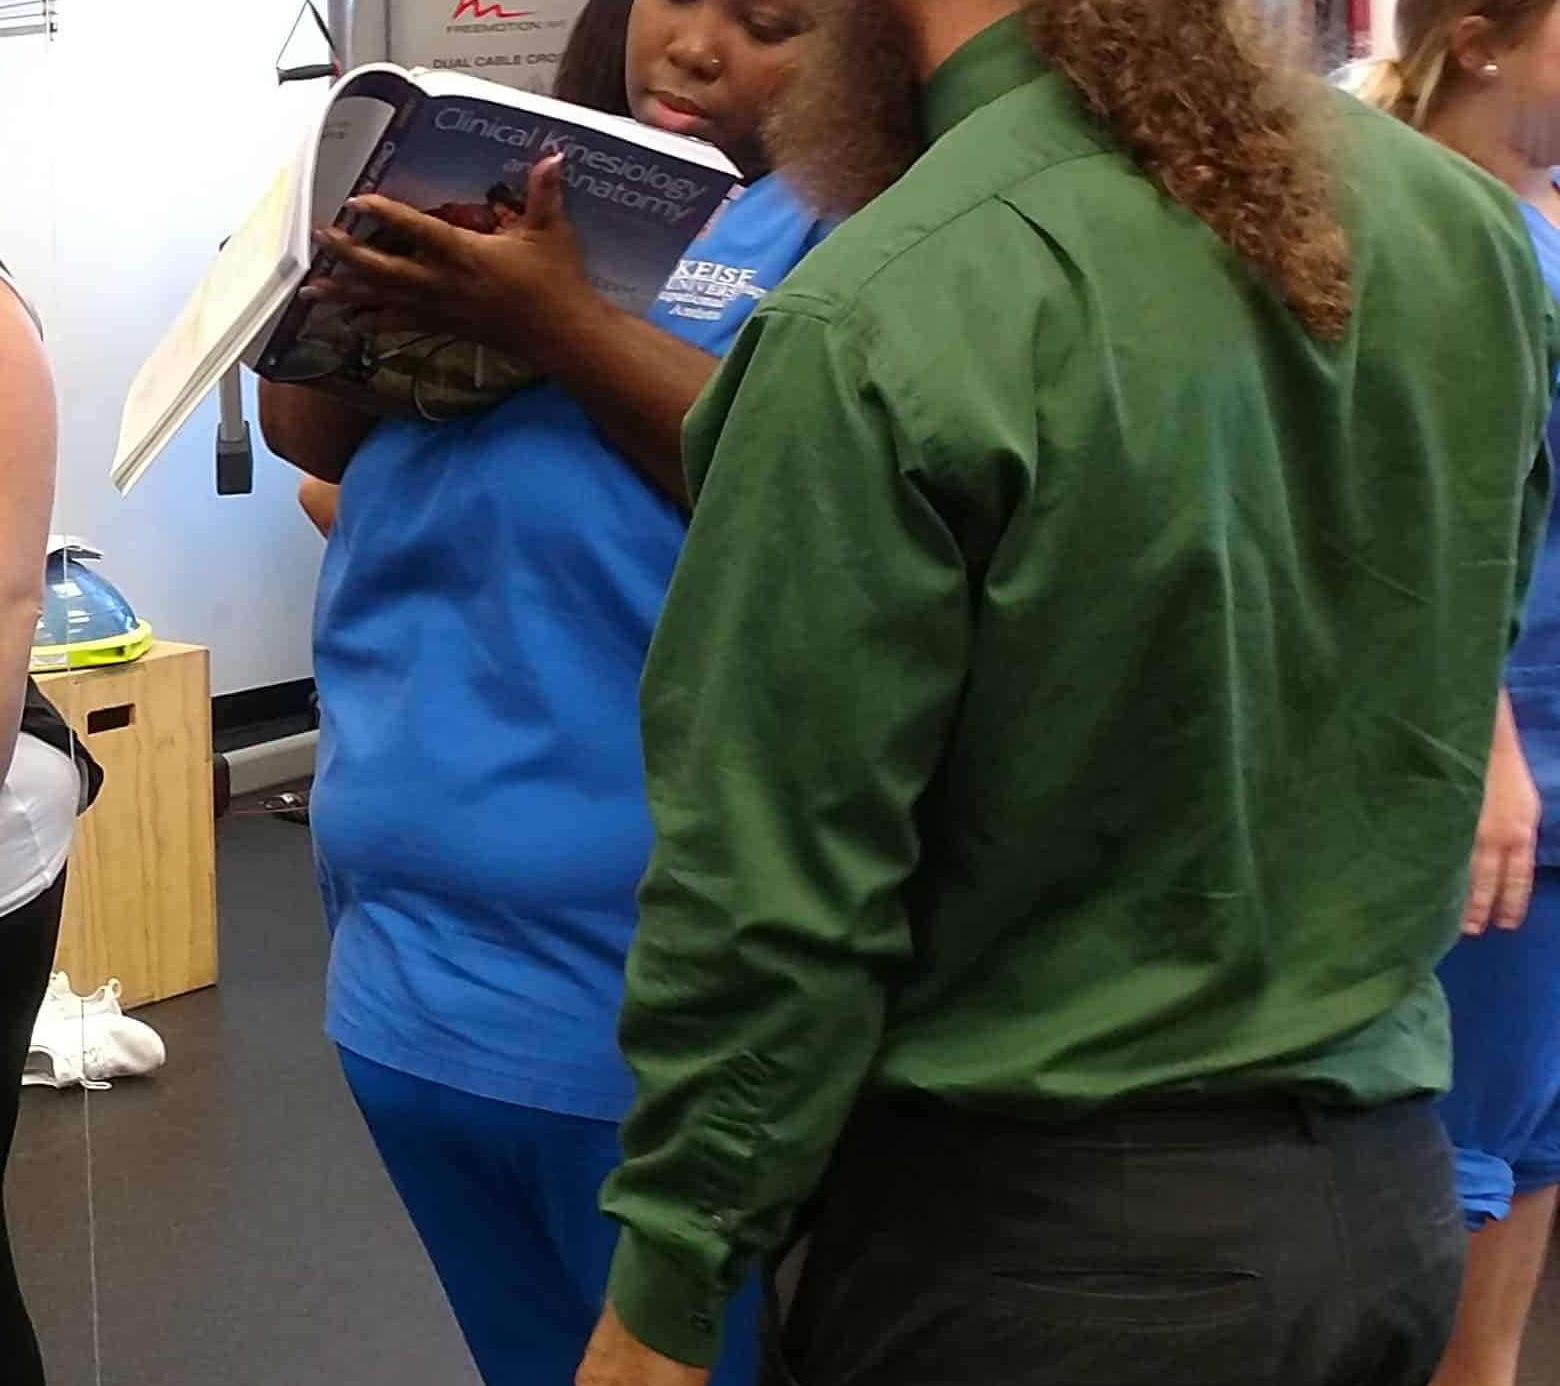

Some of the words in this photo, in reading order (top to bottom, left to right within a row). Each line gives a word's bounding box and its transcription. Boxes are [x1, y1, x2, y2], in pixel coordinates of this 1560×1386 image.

[433, 58, 472, 69] DUAL
[474, 55, 521, 67] CABLE
[434, 108, 538, 149] Clinical
[539, 128, 709, 201] Kinesiology
[503, 158, 534, 176] an
[560, 163, 696, 222] Anatomy
